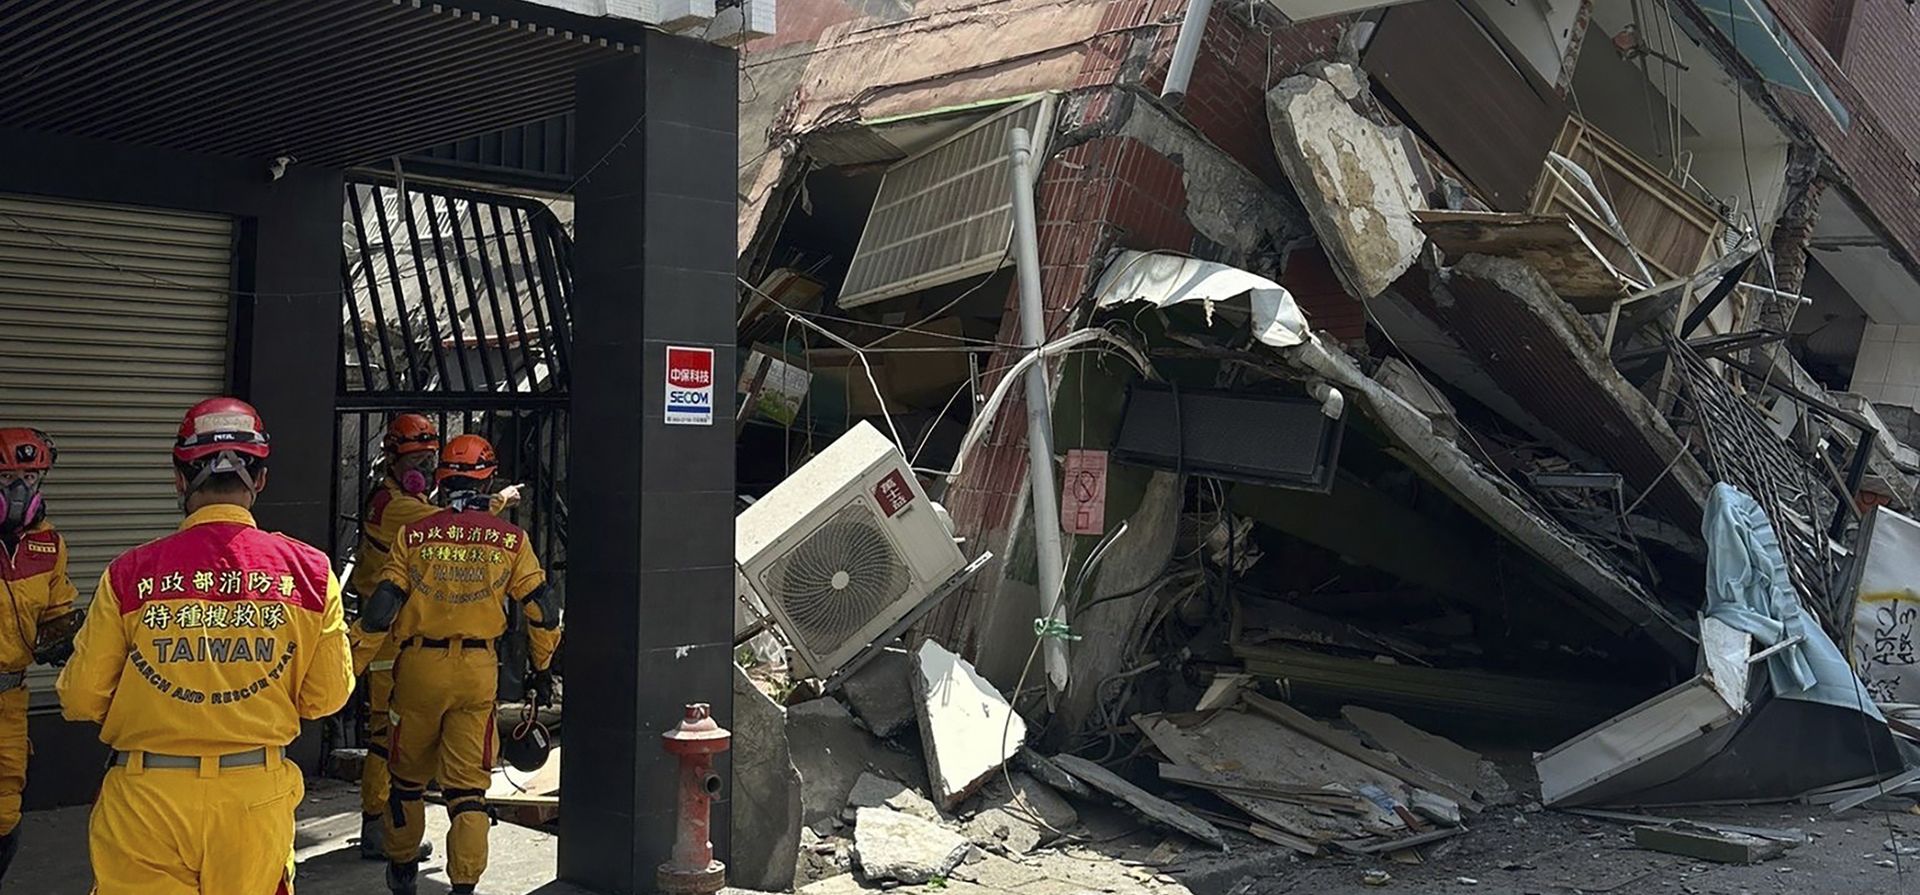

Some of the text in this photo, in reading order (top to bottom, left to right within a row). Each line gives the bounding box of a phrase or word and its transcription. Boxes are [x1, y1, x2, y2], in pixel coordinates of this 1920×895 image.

[671, 368, 709, 383] 中保科技
[670, 391, 708, 404] SECOM
[137, 571, 297, 599] 內政部消防署
[143, 603, 287, 630] 特種搜救隊
[153, 636, 275, 663] TAIWAN
[171, 687, 205, 704] AND
[211, 676, 270, 704] RESCUE
